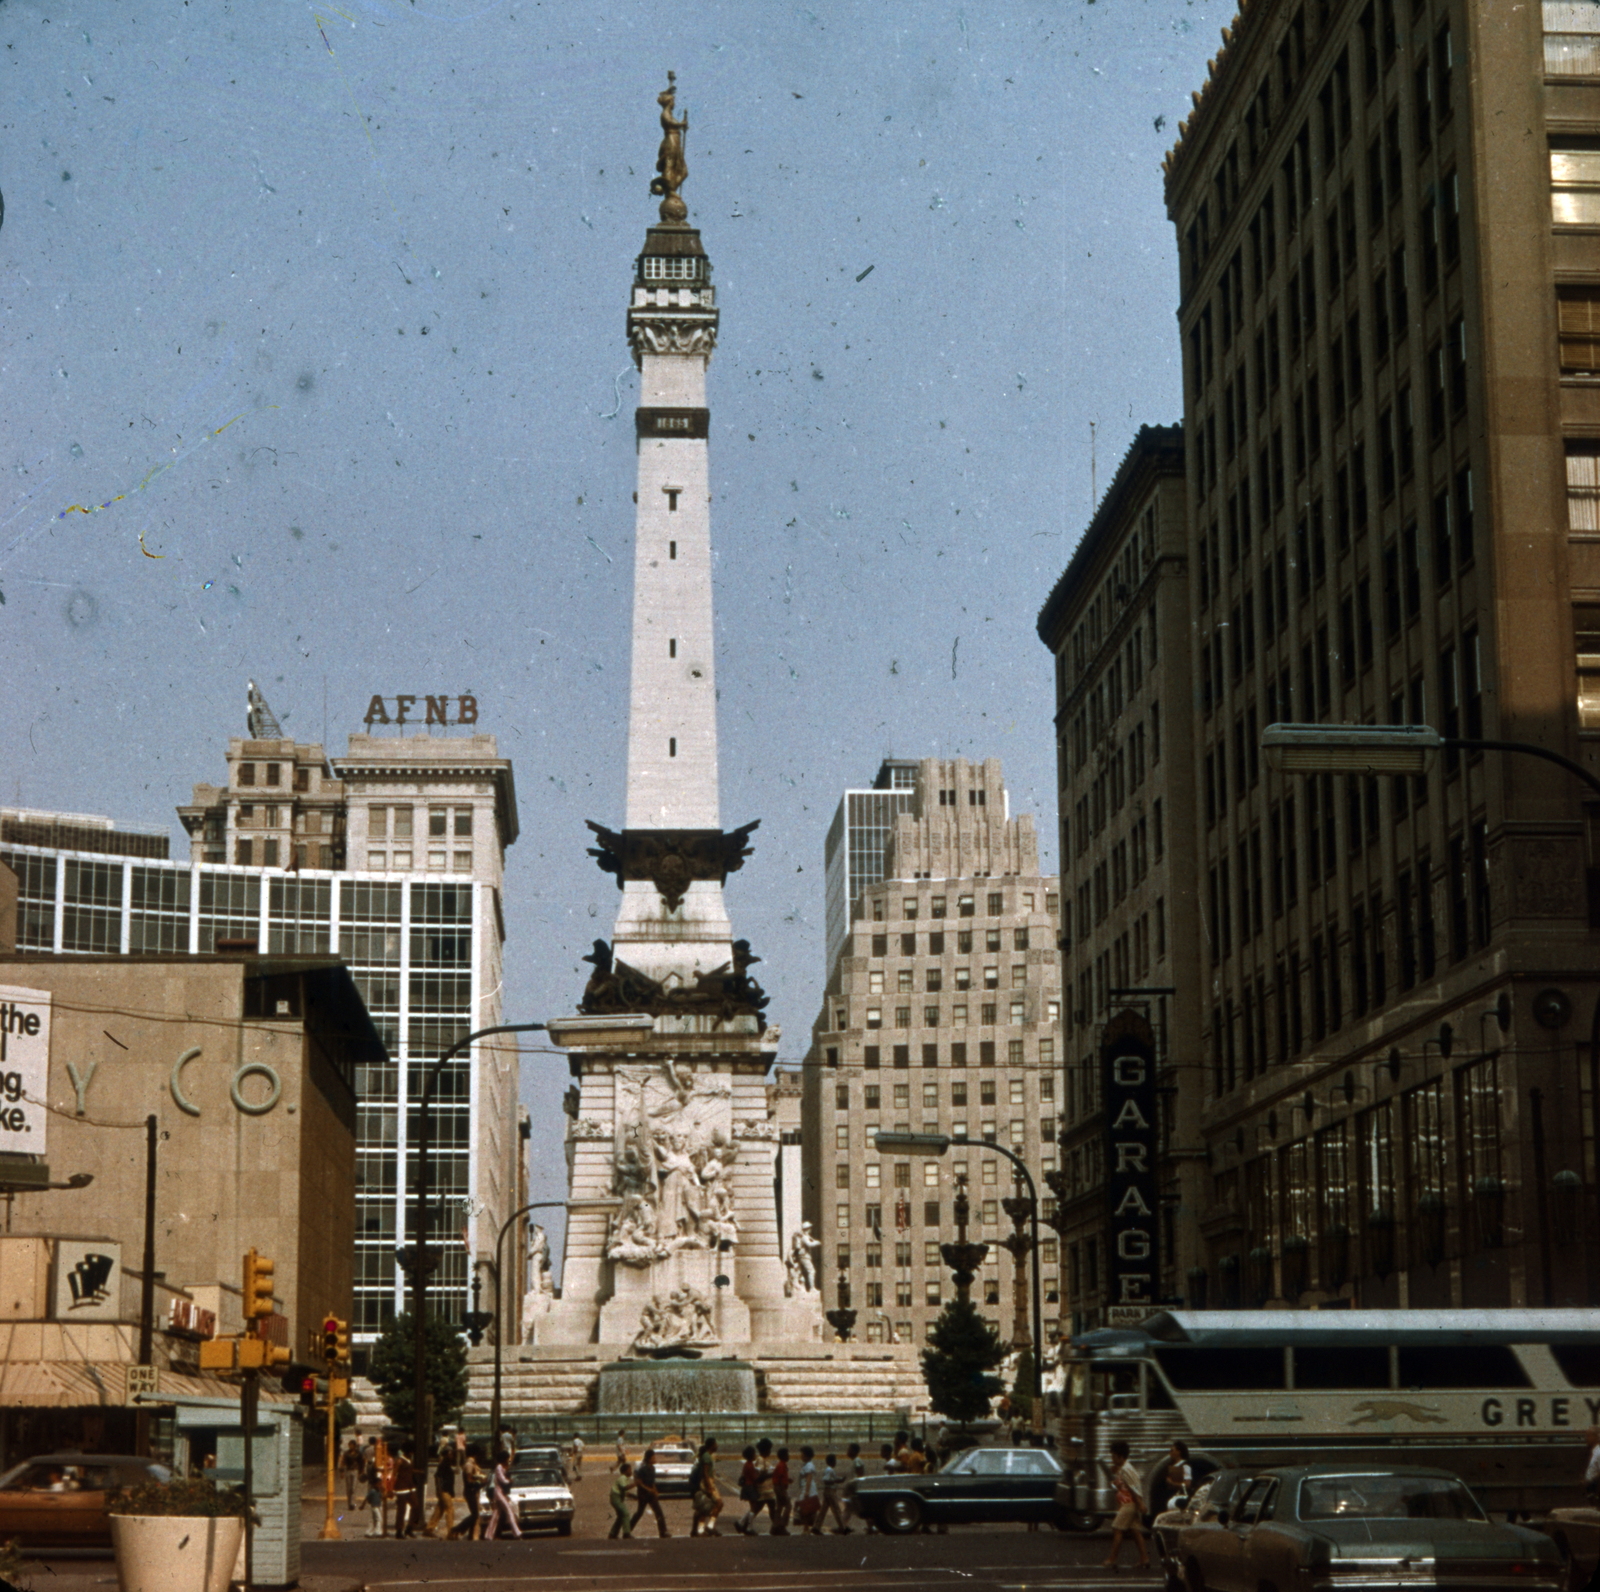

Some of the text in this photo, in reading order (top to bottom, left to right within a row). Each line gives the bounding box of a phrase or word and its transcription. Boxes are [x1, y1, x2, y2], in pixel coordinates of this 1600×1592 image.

[363, 694, 478, 725] AFNB
[0, 1002, 40, 1036] the
[170, 1046, 296, 1117] CO.
[1112, 1055, 1152, 1304] GARAGE
[129, 1382, 155, 1393] WAY
[130, 1369, 155, 1379] ONE
[1481, 1397, 1600, 1427] GREY
